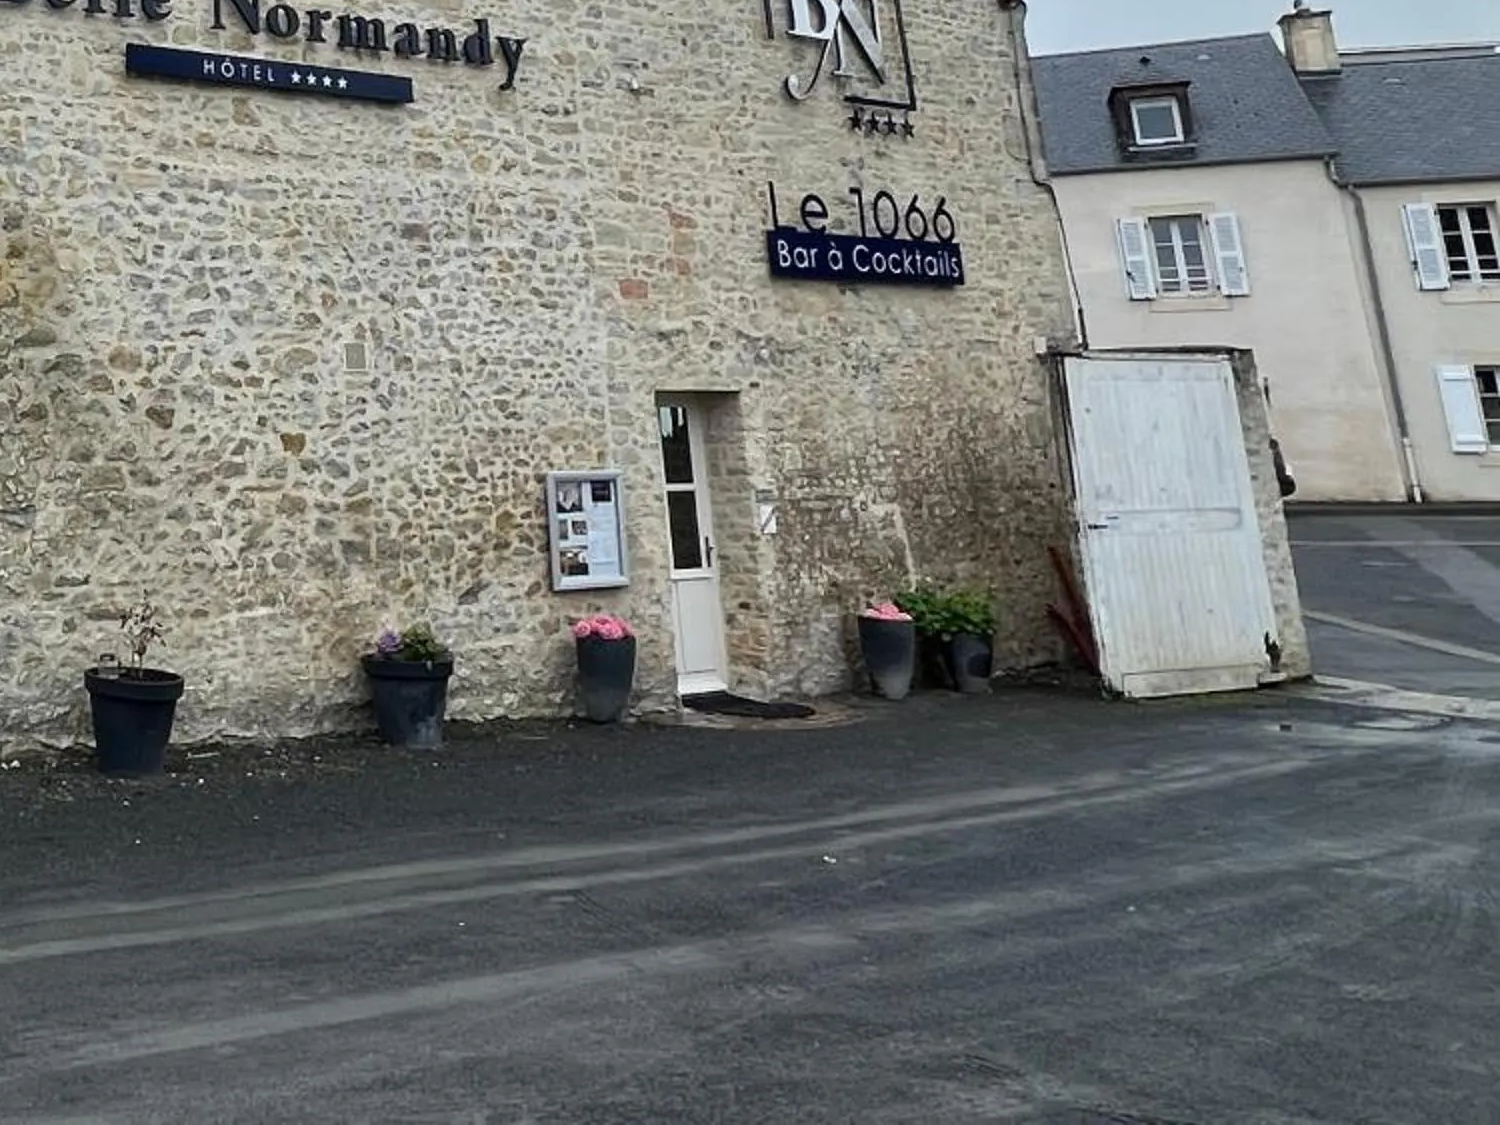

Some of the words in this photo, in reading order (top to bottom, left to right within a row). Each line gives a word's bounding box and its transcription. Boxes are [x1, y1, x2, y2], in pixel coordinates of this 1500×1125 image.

[203, 57, 275, 82] HÔTEL
[768, 180, 829, 233] Le
[849, 187, 956, 244] 1066
[777, 239, 819, 269] Bar
[827, 242, 844, 271] à
[852, 244, 960, 278] Cocktails
